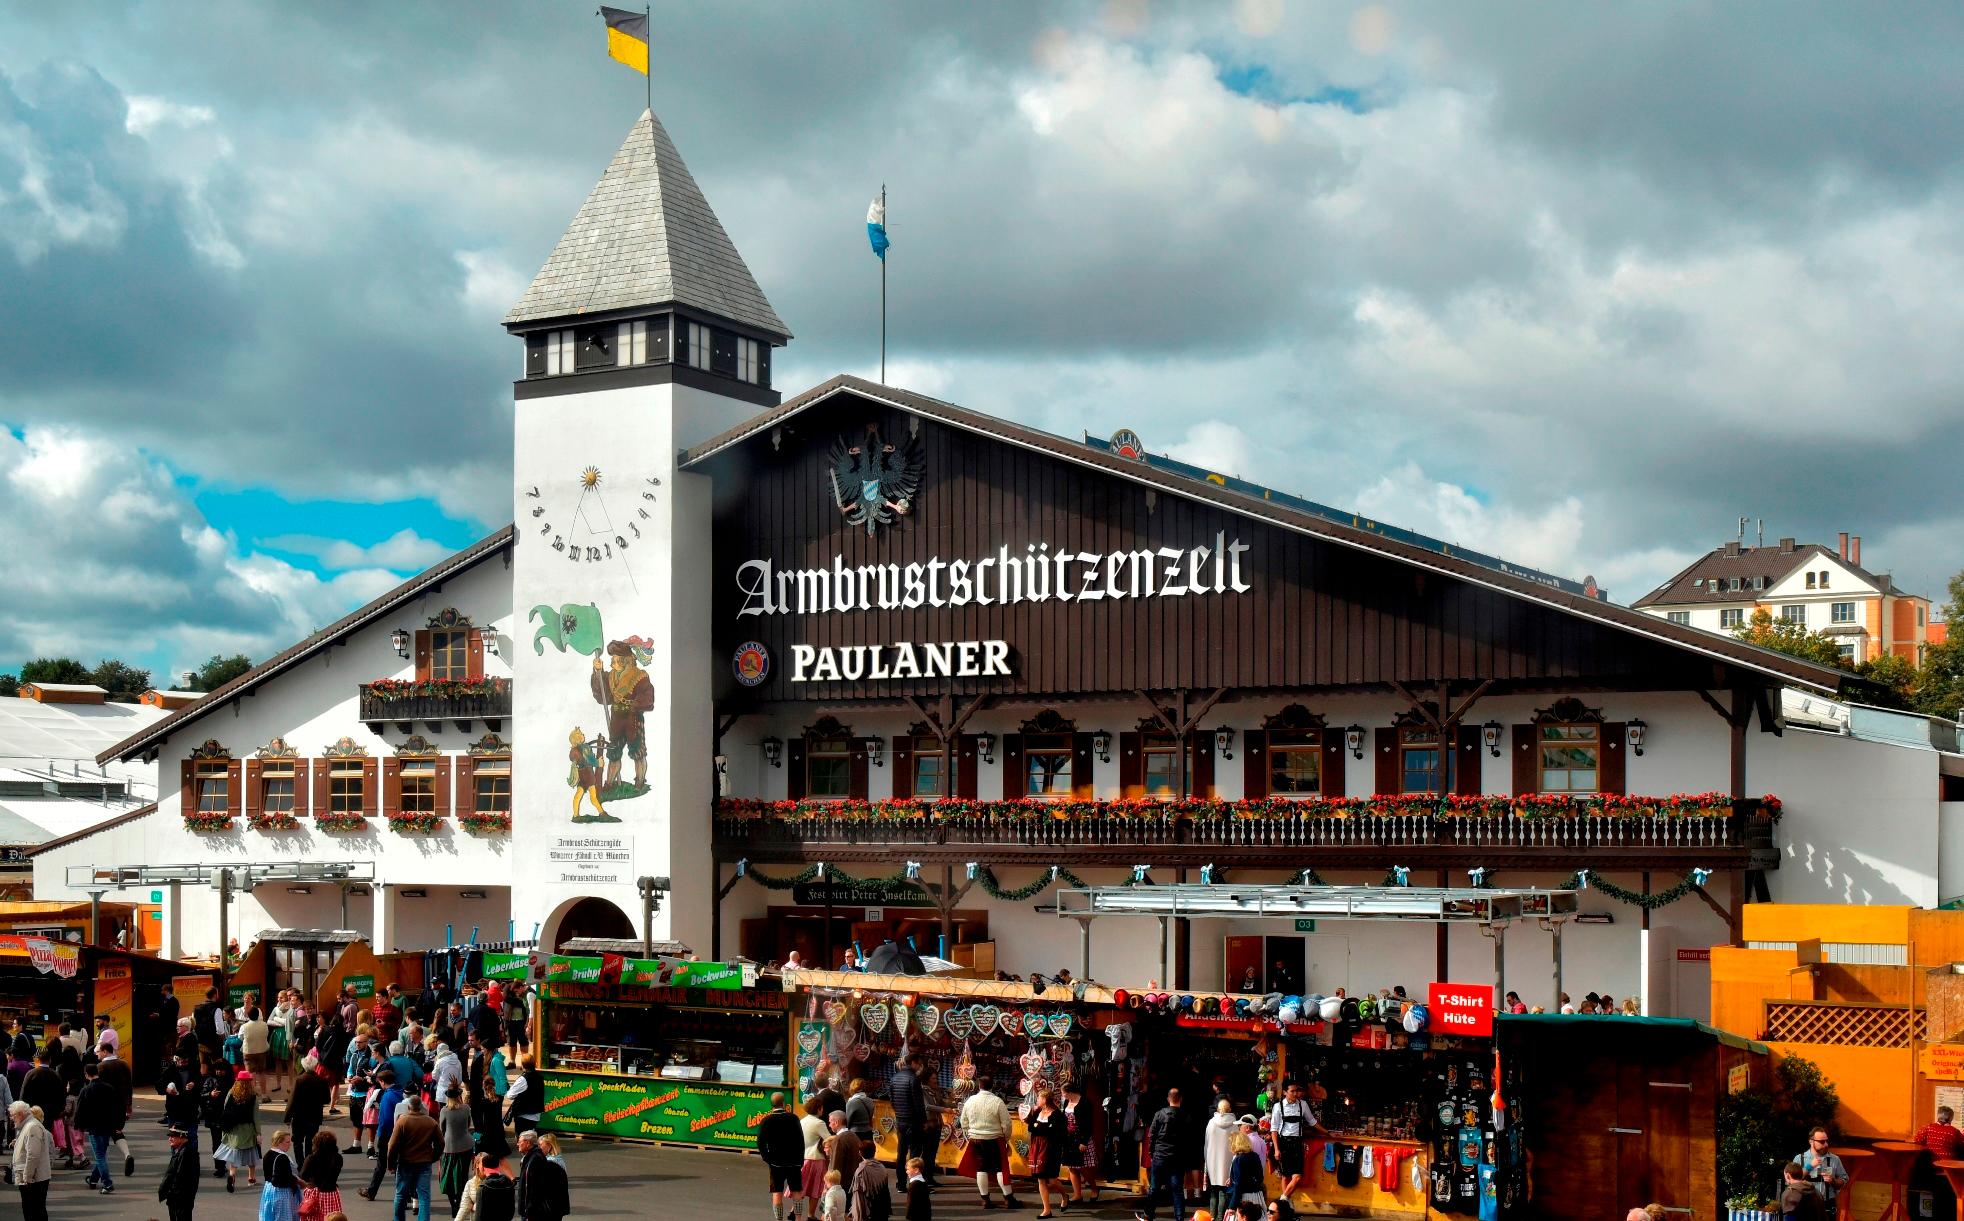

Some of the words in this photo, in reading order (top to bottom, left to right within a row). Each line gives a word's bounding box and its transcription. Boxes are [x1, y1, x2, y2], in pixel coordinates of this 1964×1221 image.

[646, 477, 661, 486] 6
[643, 492, 656, 502] 5
[532, 507, 545, 517] 8
[637, 508, 651, 519] 4
[541, 523, 551, 536] 9
[628, 522, 640, 539] 3
[552, 535, 565, 551] 10
[616, 536, 628, 549] 2
[568, 545, 581, 562] 11
[586, 546, 602, 562] 12
[604, 542, 612, 559] 1
[736, 530, 1251, 620] Armbrustschützenzelt
[791, 640, 1012, 682] PAULANER
[851, 889, 878, 901] Peter
[29, 947, 52, 962] Pizza
[486, 957, 529, 975] Leberkäse
[1438, 994, 1483, 1007] T-Shirt
[1444, 1012, 1476, 1025] Hüte
[598, 1081, 647, 1093] Speckfladen
[684, 1085, 729, 1096] Emmentaler
[731, 1090, 745, 1098] vom
[748, 1089, 765, 1099] Laib
[690, 1104, 737, 1132] Schnitzel
[641, 1121, 674, 1135] Brezen
